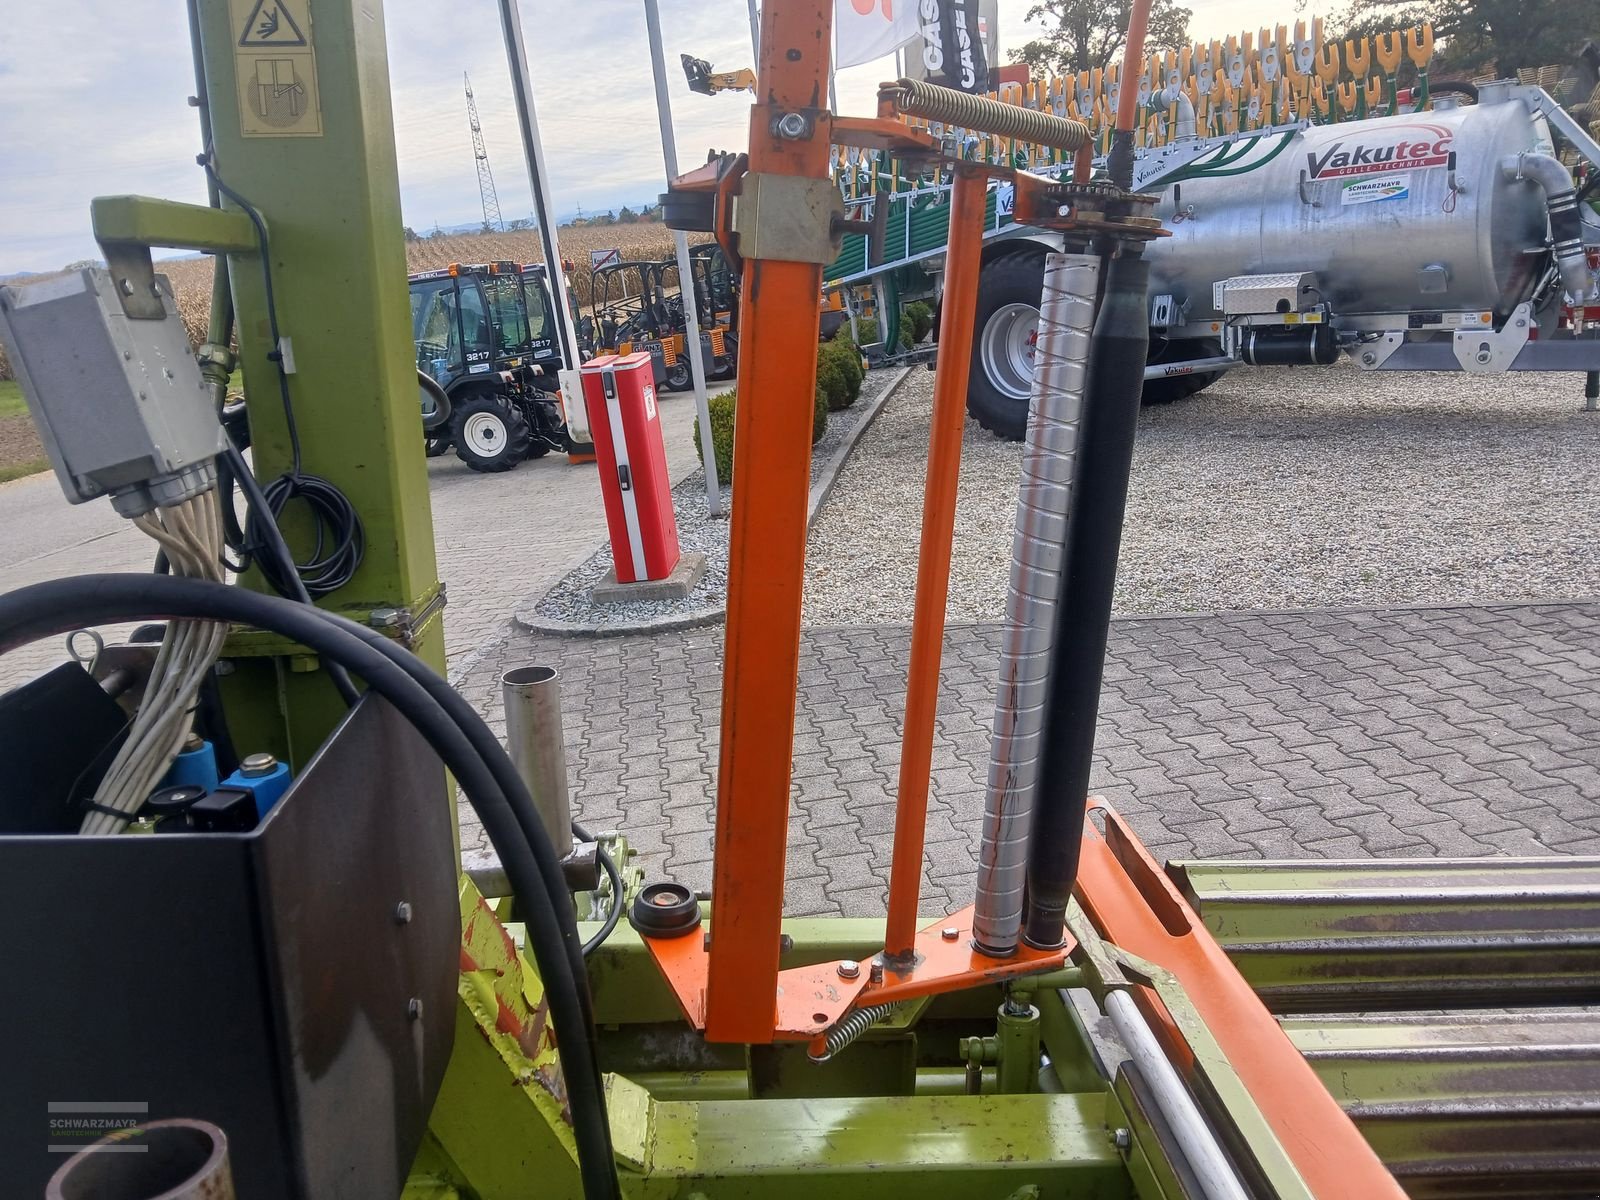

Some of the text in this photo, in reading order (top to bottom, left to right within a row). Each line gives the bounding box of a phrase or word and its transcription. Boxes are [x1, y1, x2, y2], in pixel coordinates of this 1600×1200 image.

[1306, 140, 1452, 179] Vakutec
[1348, 180, 1401, 192] SCHWARZMAYR
[417, 272, 438, 280] ISEKI
[531, 339, 551, 348] 3217
[466, 351, 490, 361] 3217
